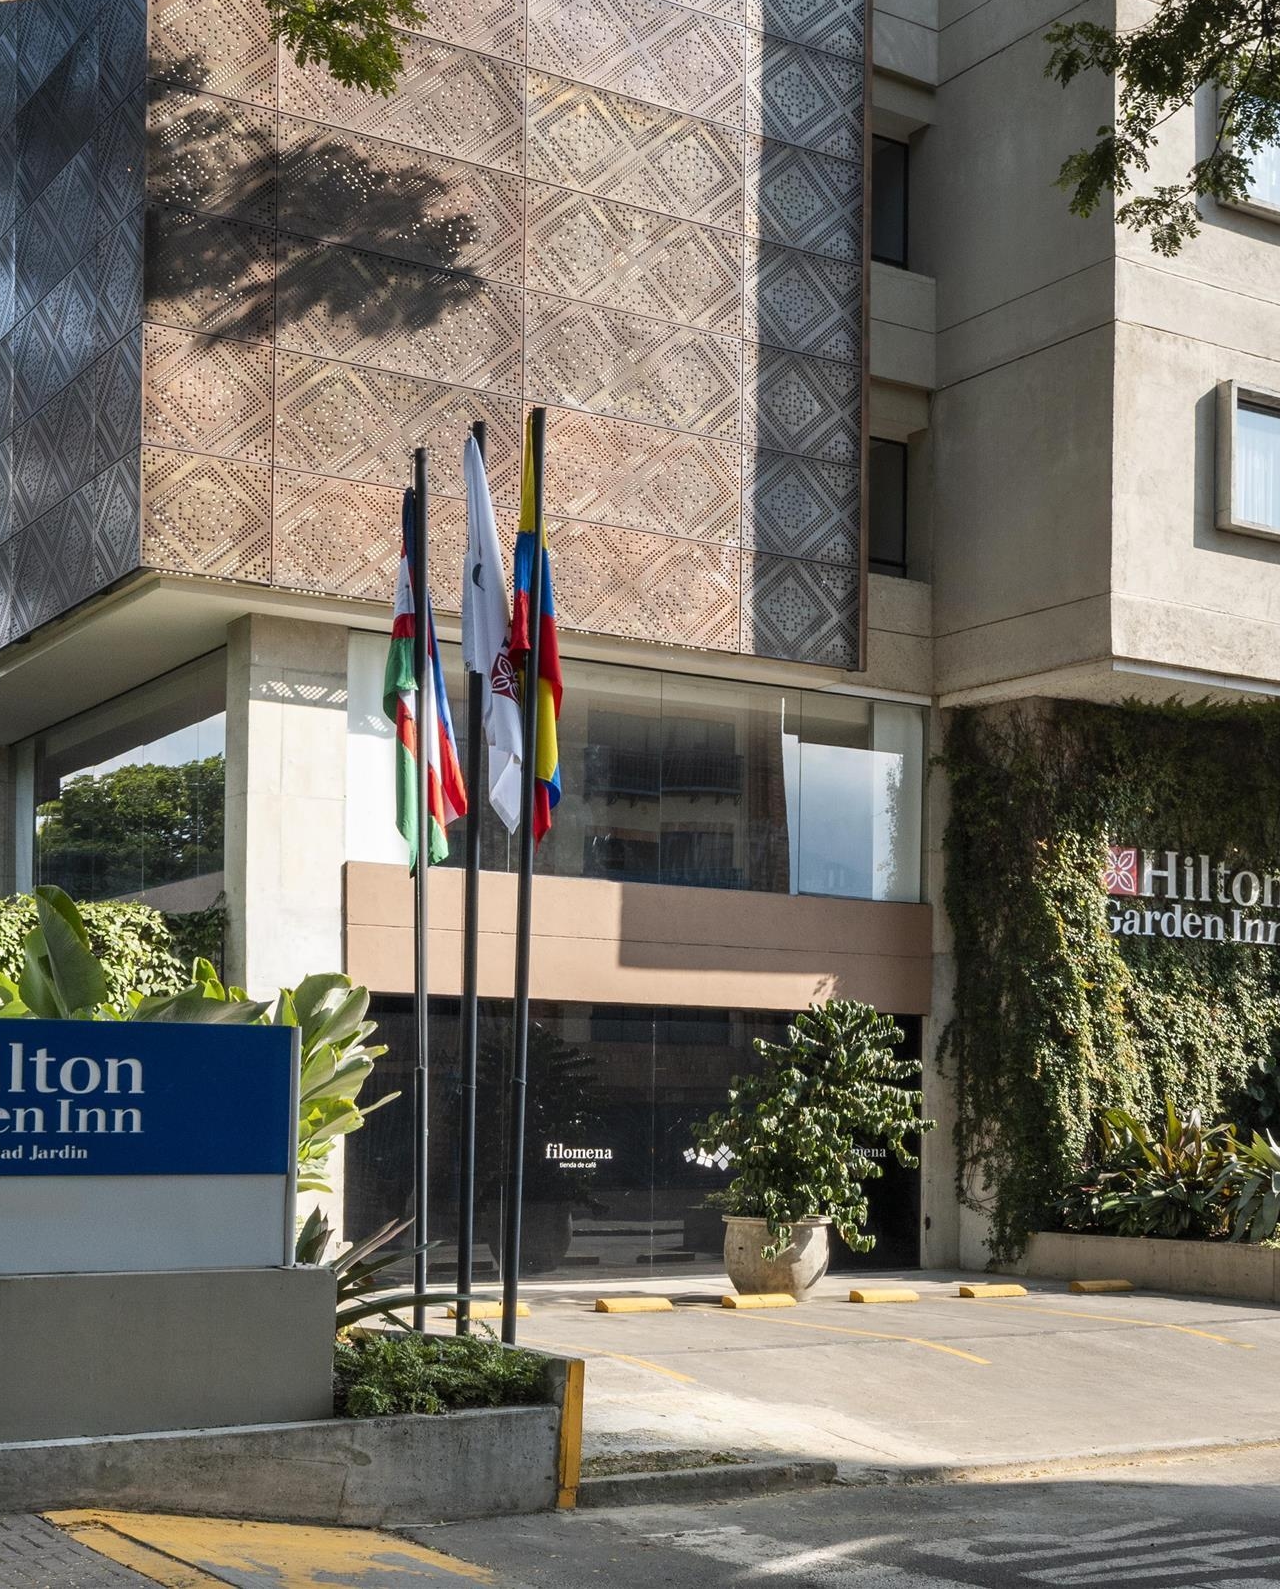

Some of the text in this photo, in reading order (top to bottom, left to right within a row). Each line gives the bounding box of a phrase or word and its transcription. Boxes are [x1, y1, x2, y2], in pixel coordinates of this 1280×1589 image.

[1107, 899, 1225, 941] Garden
[56, 1099, 145, 1133] Inn
[29, 1145, 88, 1161] Jardin
[545, 1142, 613, 1159] filomena
